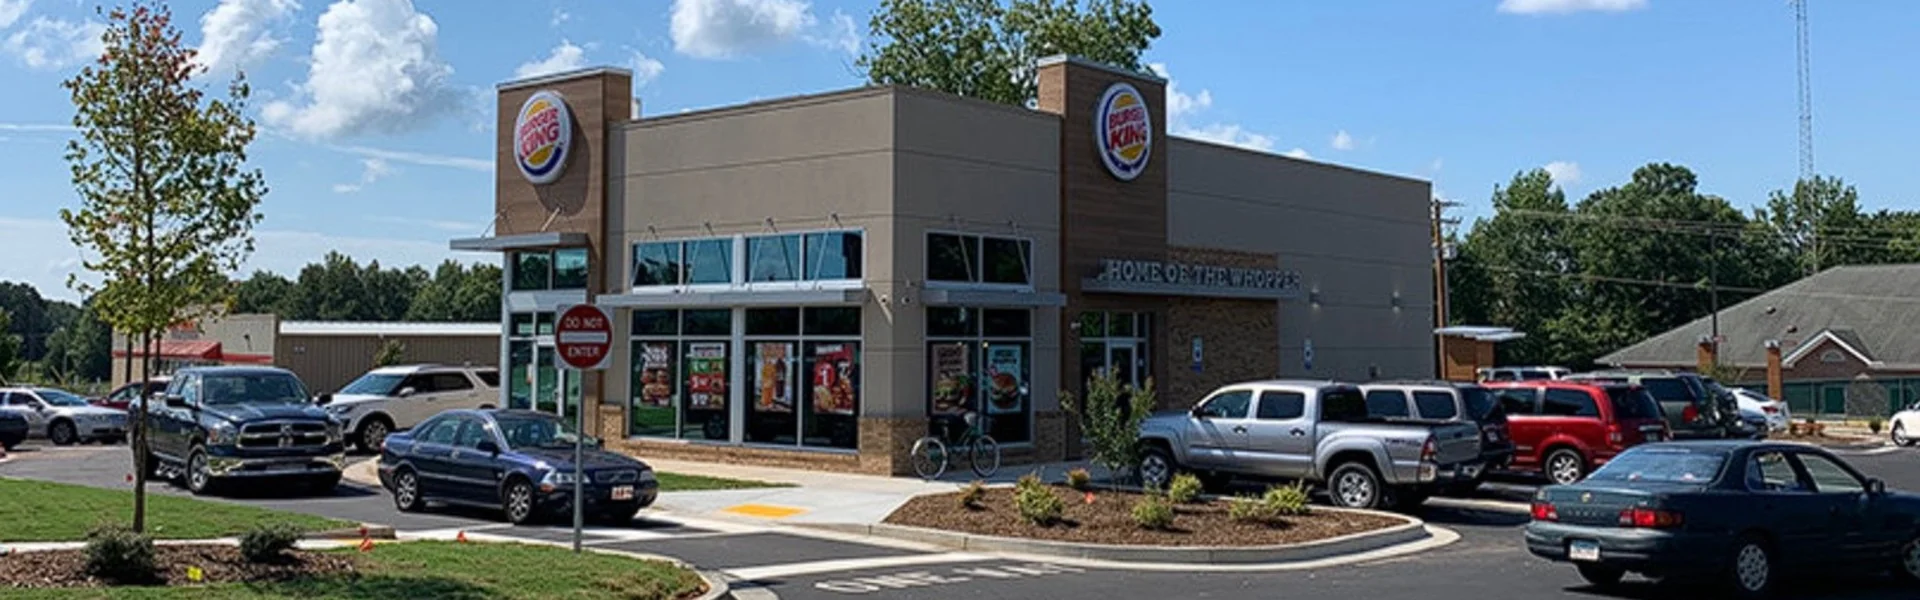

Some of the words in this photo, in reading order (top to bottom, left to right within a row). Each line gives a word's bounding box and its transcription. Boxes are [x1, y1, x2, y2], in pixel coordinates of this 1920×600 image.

[521, 121, 560, 159] KING
[1109, 258, 1163, 283] HOME
[1165, 262, 1188, 284] OF
[1193, 264, 1228, 287] THE
[1229, 267, 1302, 290] WHOPPER
[564, 316, 580, 328] DO
[582, 316, 603, 329] NOT
[567, 345, 600, 357] ENTER
